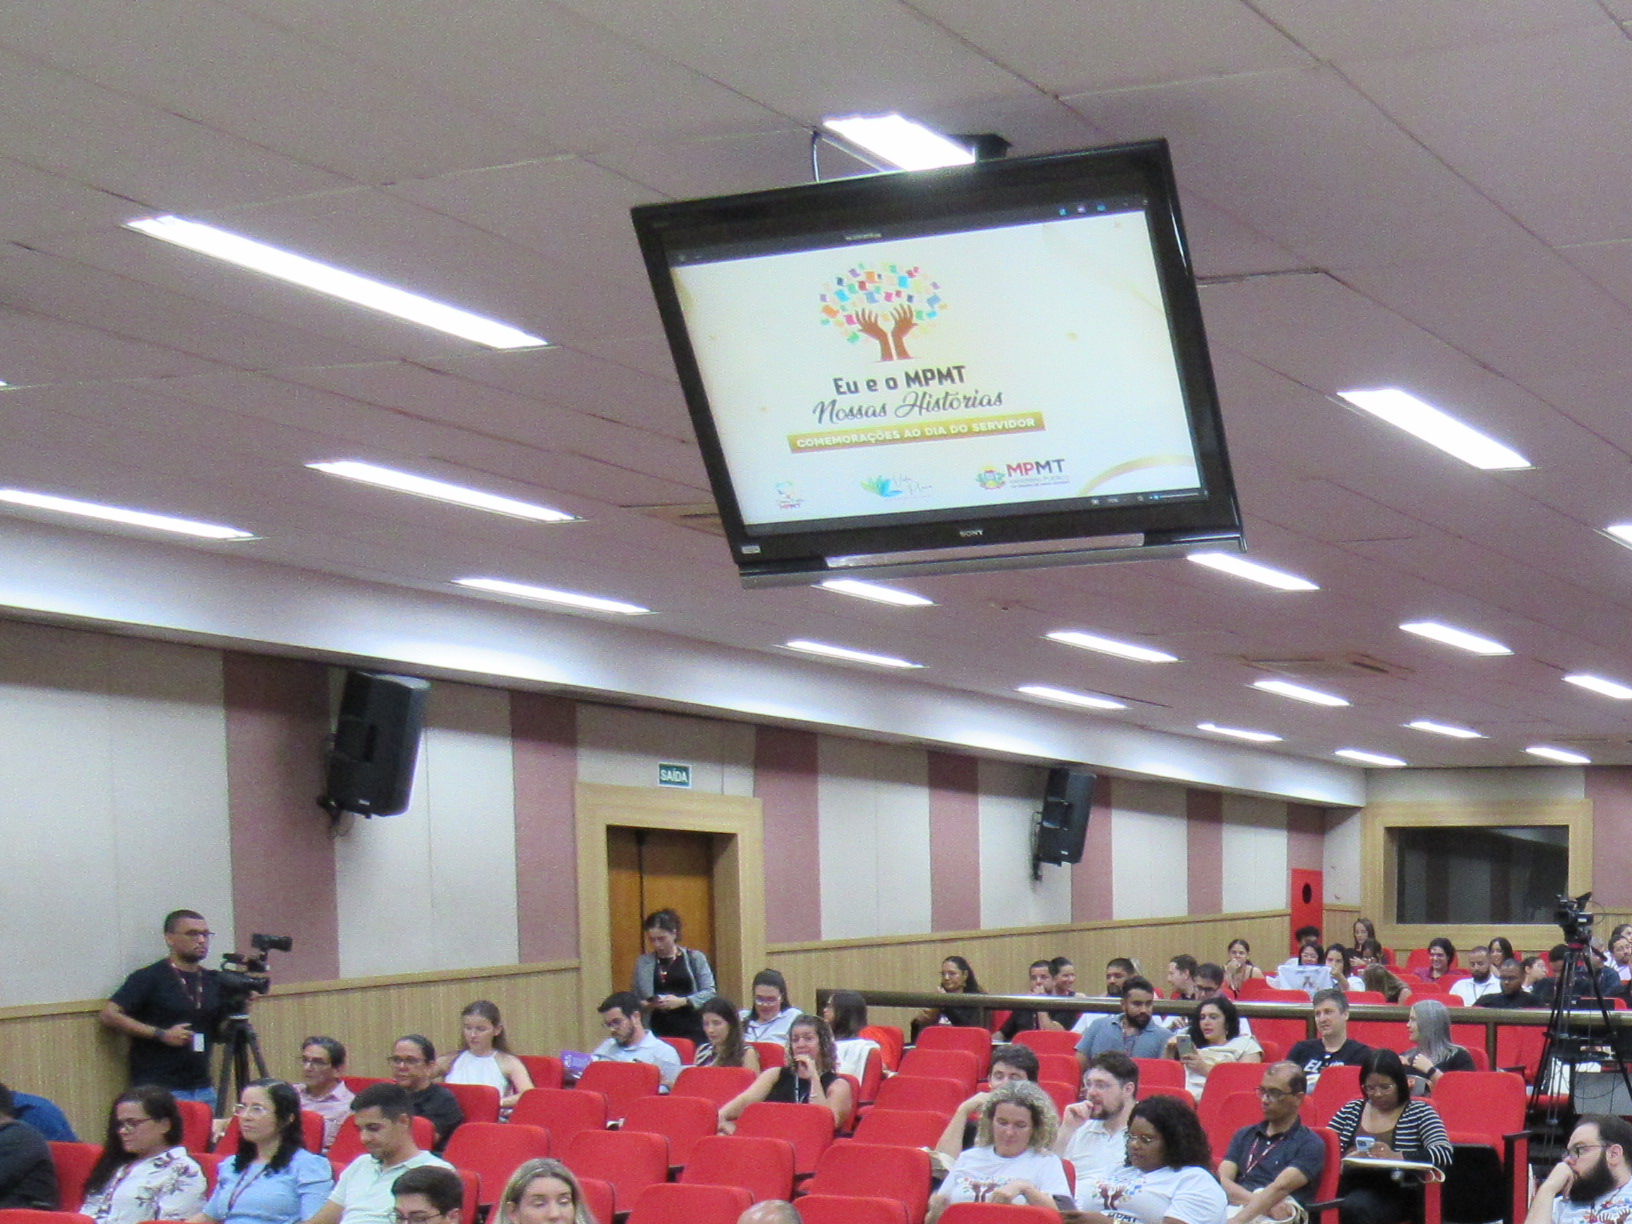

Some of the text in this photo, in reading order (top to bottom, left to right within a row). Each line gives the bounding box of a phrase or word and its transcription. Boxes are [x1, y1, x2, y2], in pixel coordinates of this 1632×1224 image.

[832, 365, 966, 395] Eu e o MPMT
[812, 399, 887, 424] Nossas
[904, 428, 920, 438] AO
[925, 425, 947, 436] DIA
[950, 423, 968, 434] DO
[972, 417, 1036, 432] SERVIDOR
[1006, 458, 1065, 478] MPMT
[660, 767, 688, 783] SAÍDA
